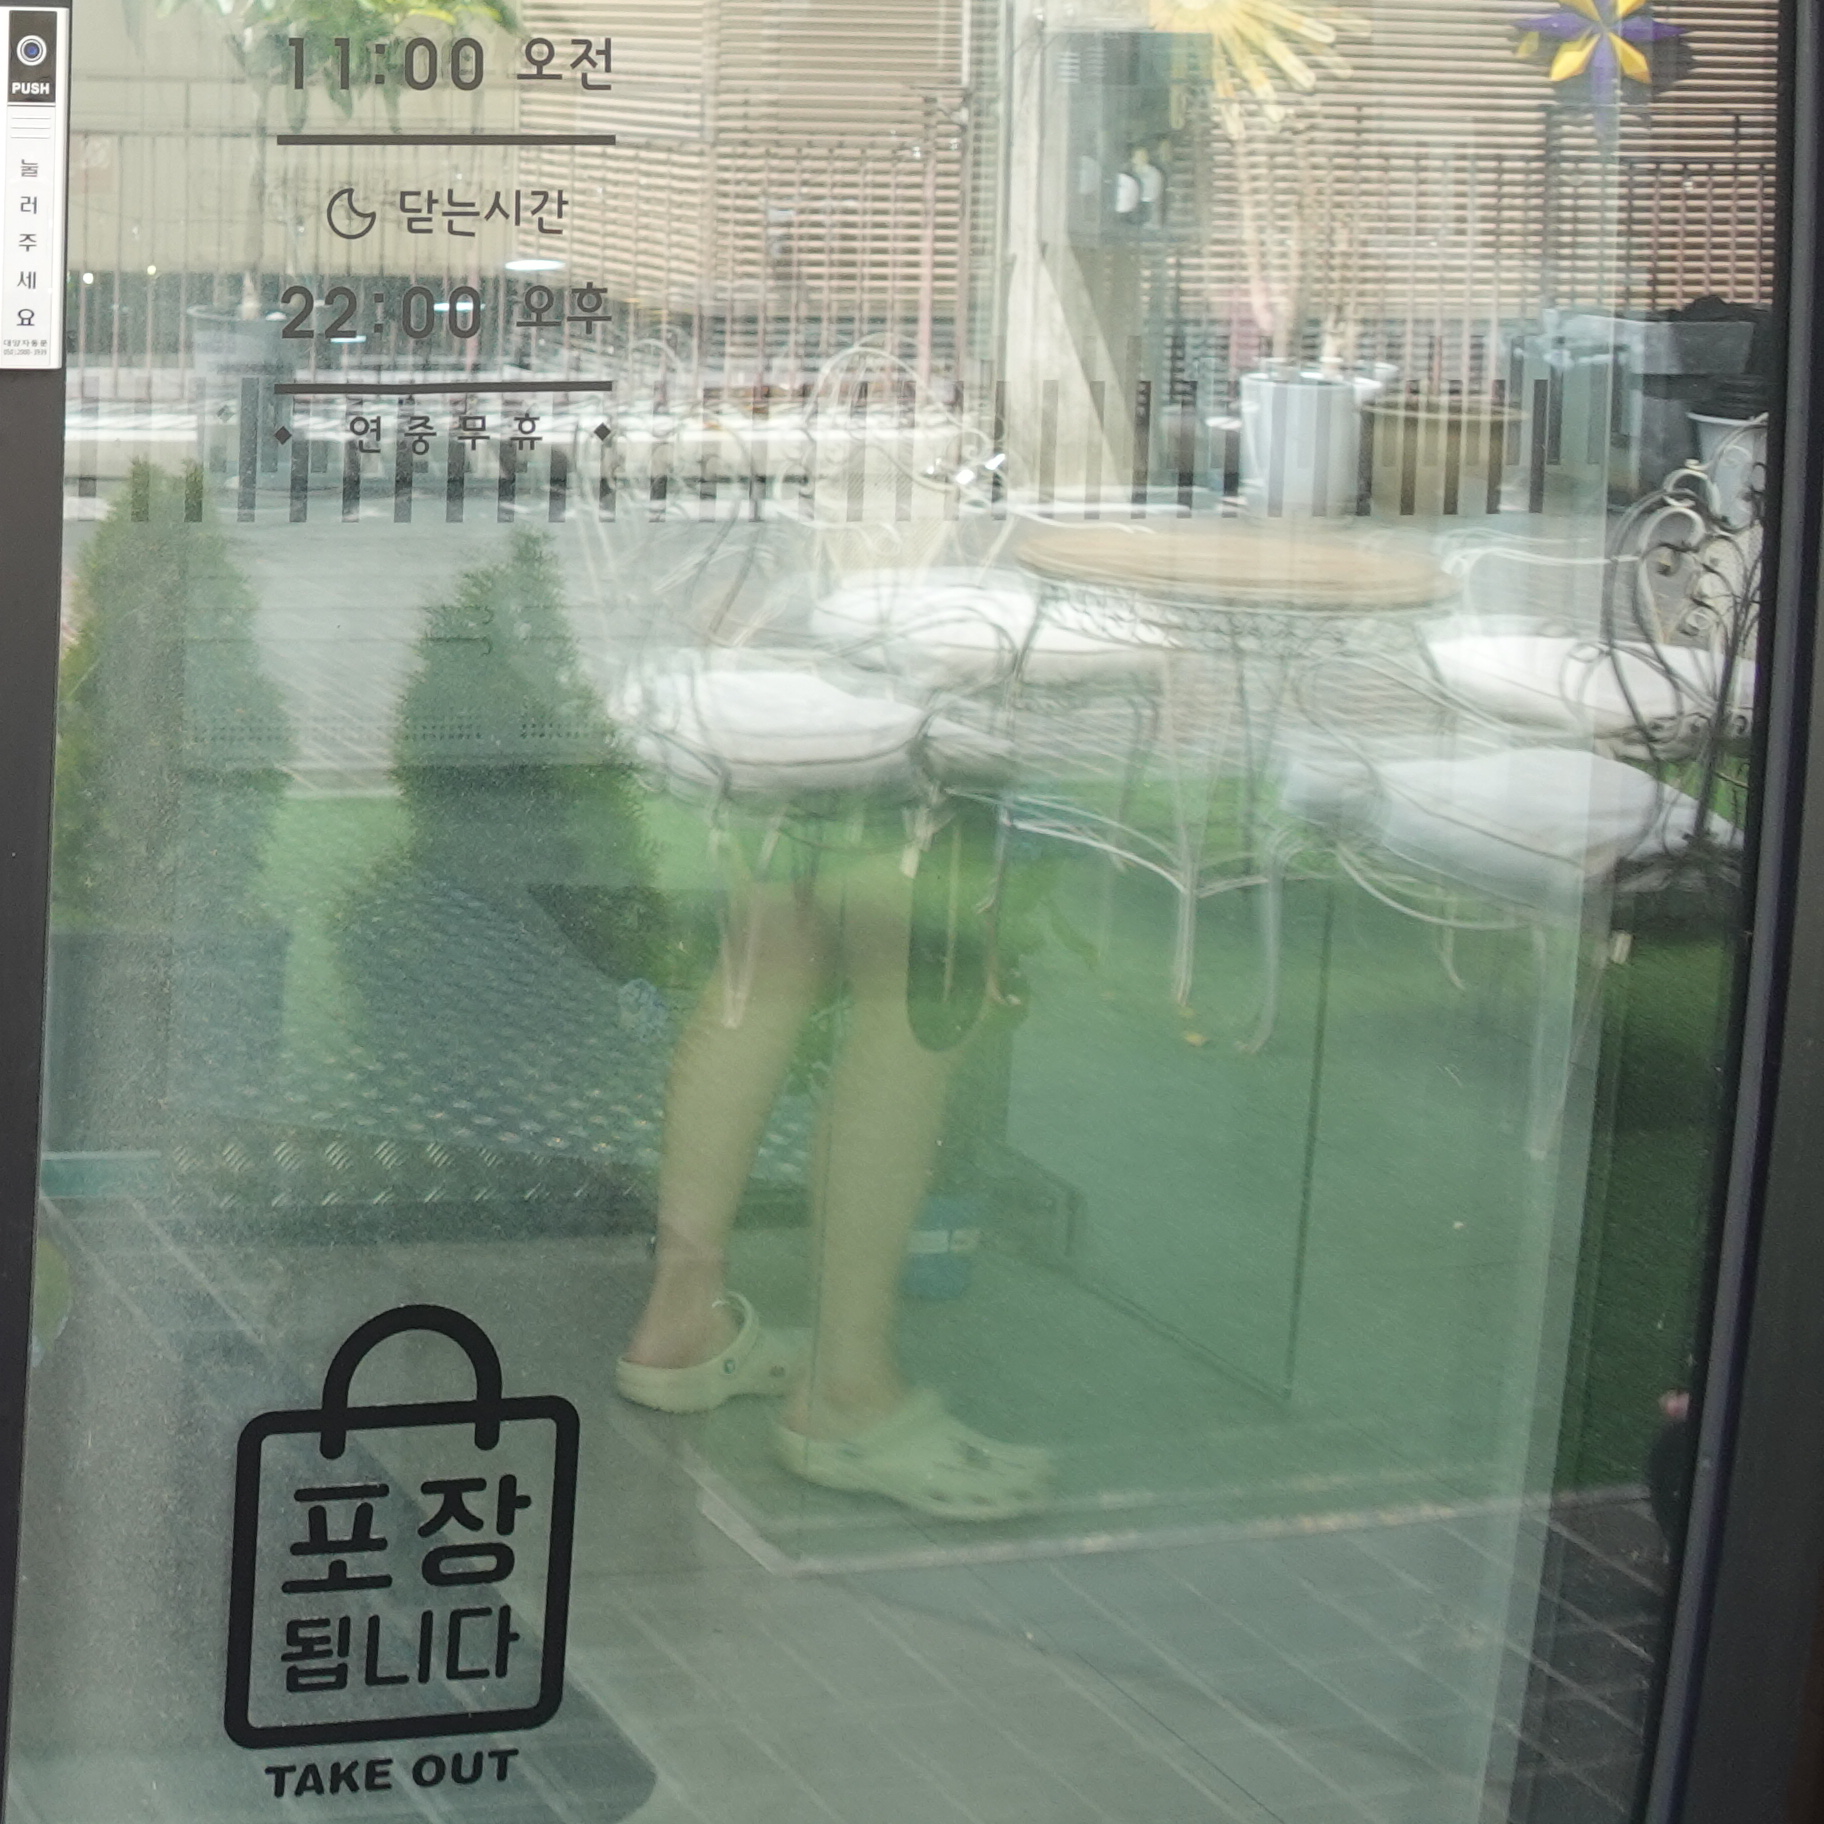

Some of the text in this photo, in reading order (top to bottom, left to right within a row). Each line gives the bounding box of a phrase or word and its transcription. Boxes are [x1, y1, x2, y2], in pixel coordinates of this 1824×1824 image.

[12, 82, 50, 95] PUSH
[288, 37, 612, 91] 11:00 오전
[399, 188, 569, 237] 닫는시간
[281, 281, 612, 339] 22:00 오후
[282, 1474, 532, 1594] 포장
[281, 1605, 520, 1693] 됩니다
[265, 1748, 520, 1798] TAKE OUT
